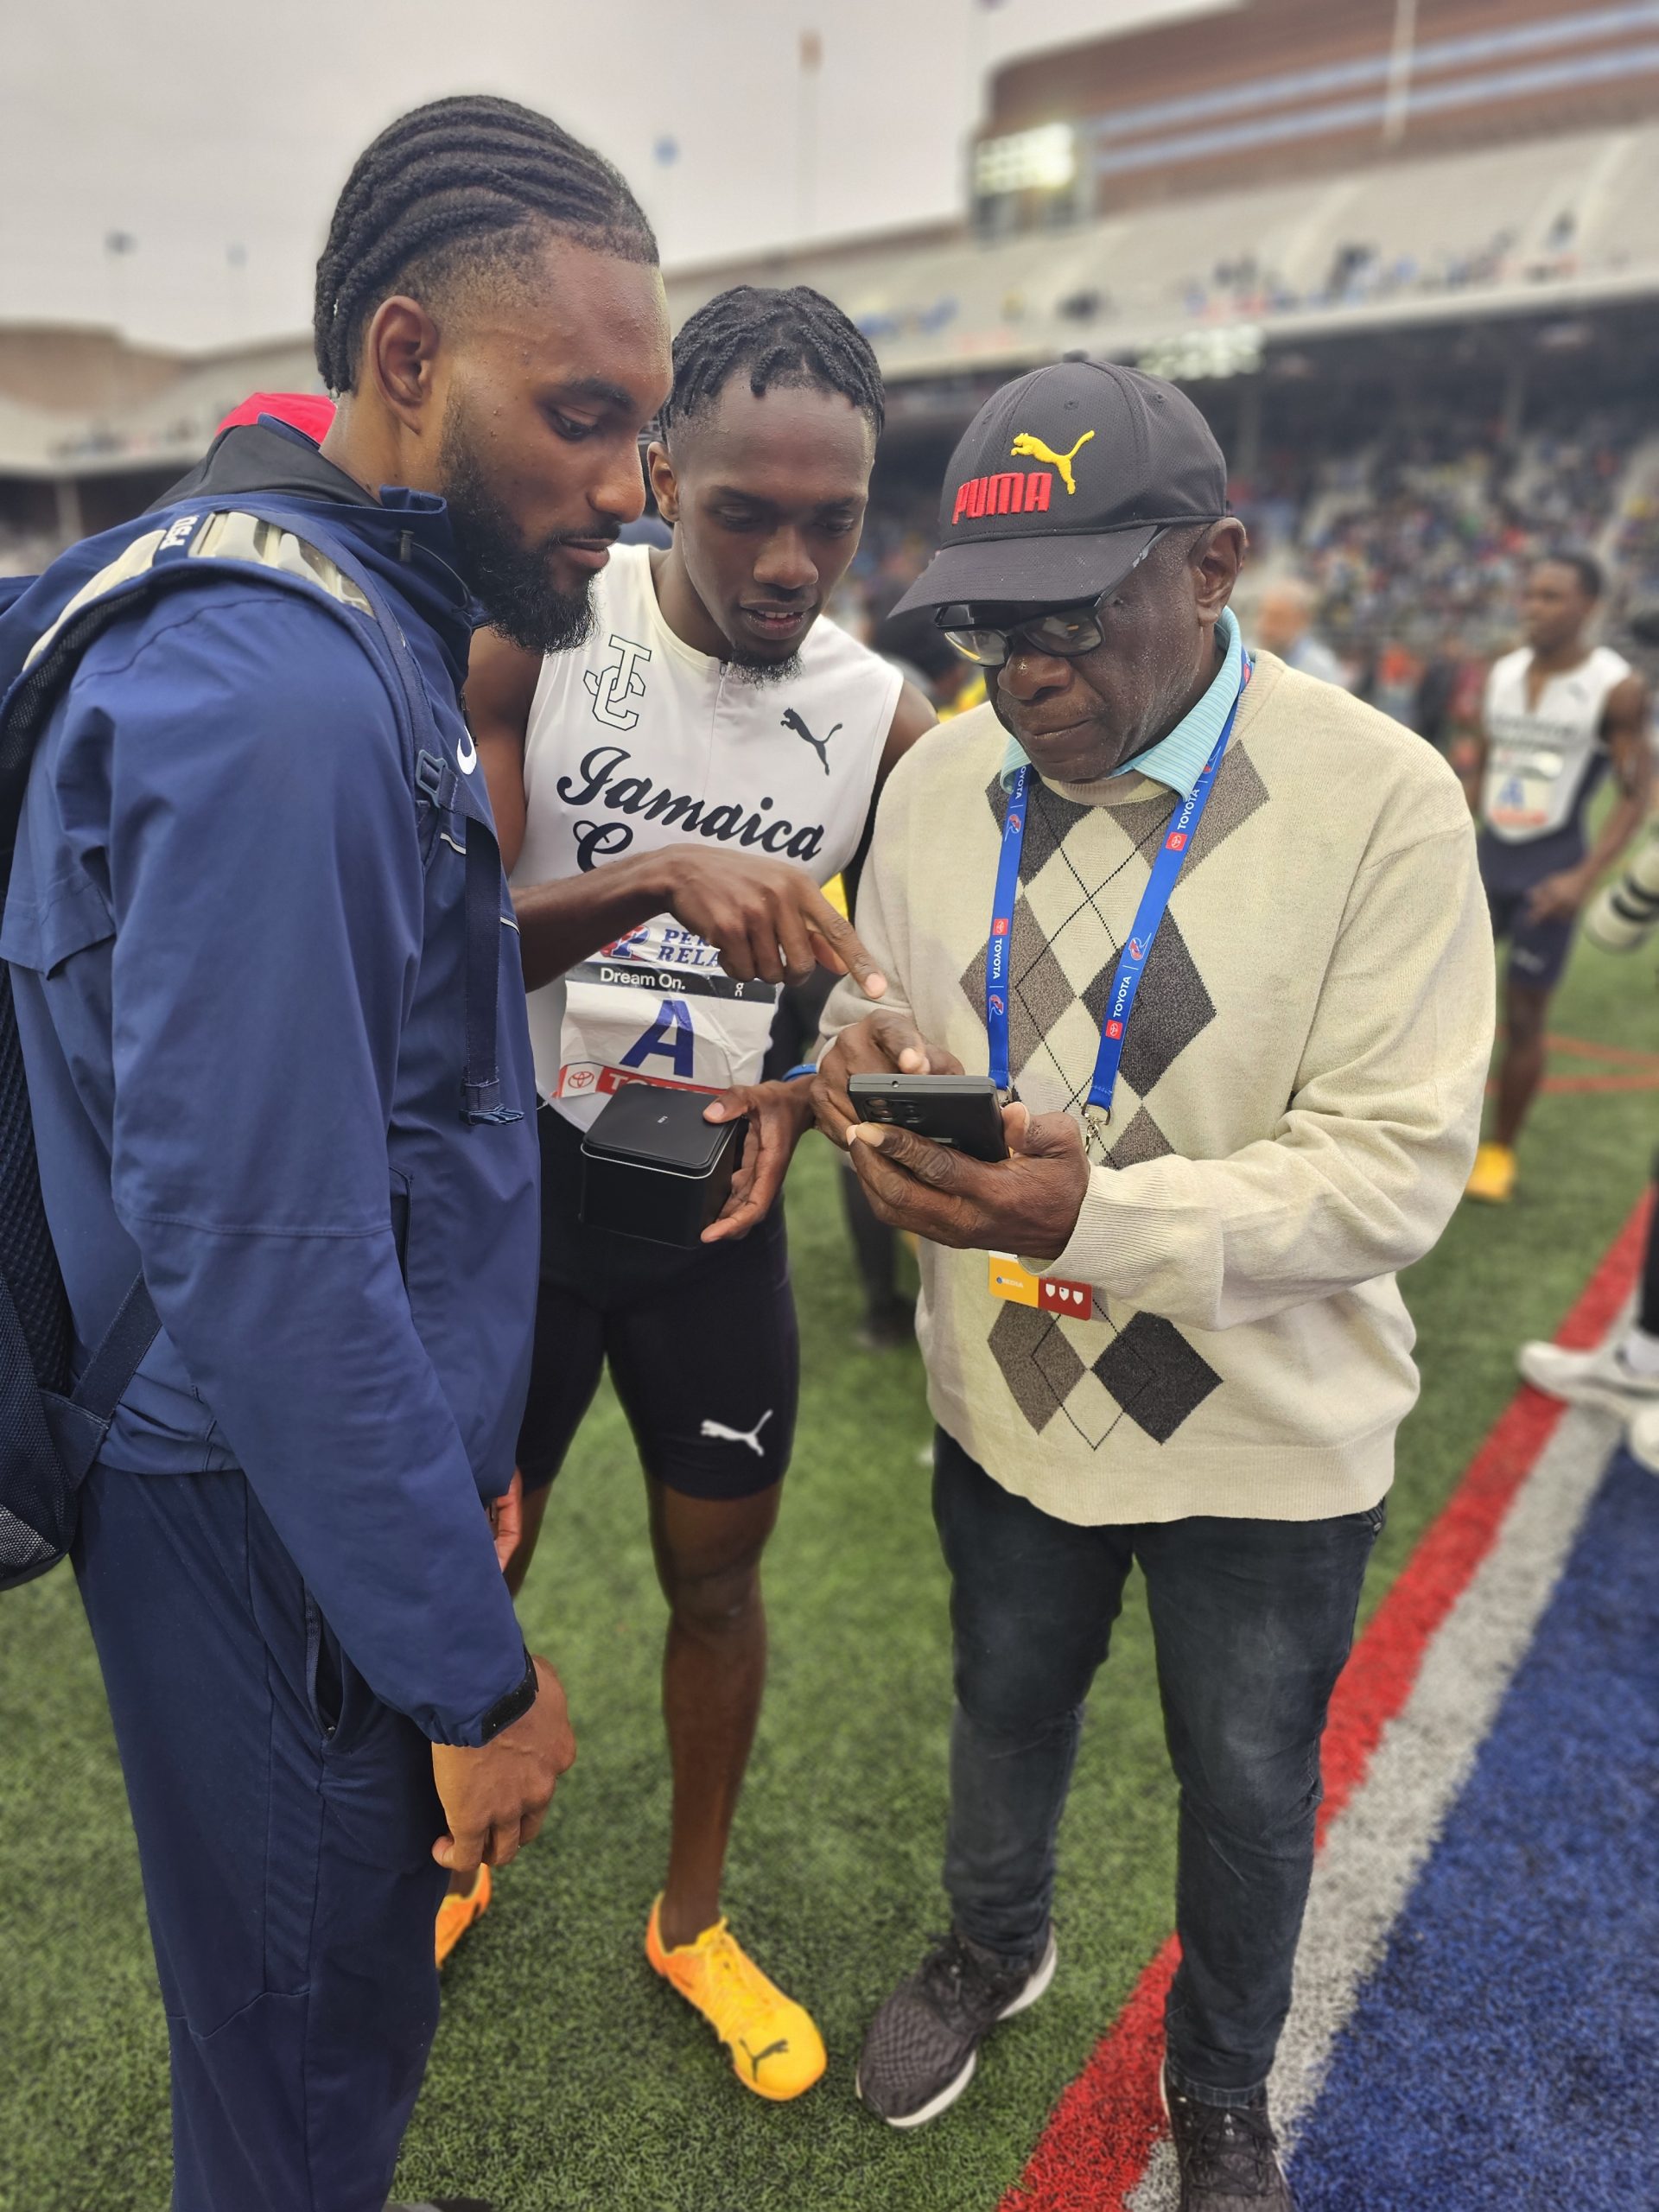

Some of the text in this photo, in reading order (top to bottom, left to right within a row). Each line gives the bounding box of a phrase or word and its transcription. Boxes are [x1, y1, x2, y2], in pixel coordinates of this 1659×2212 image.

[951, 472, 1052, 525] PUMA
[556, 747, 824, 861] Jamaica
[1014, 766, 1027, 800] OYOTA
[1177, 789, 1200, 830] TOYOTA
[657, 945, 721, 967] RELA
[993, 938, 1003, 980] TOYOTA
[600, 968, 686, 990] Dream On.
[1113, 976, 1132, 1018] TOYOTA
[620, 999, 695, 1079] A
